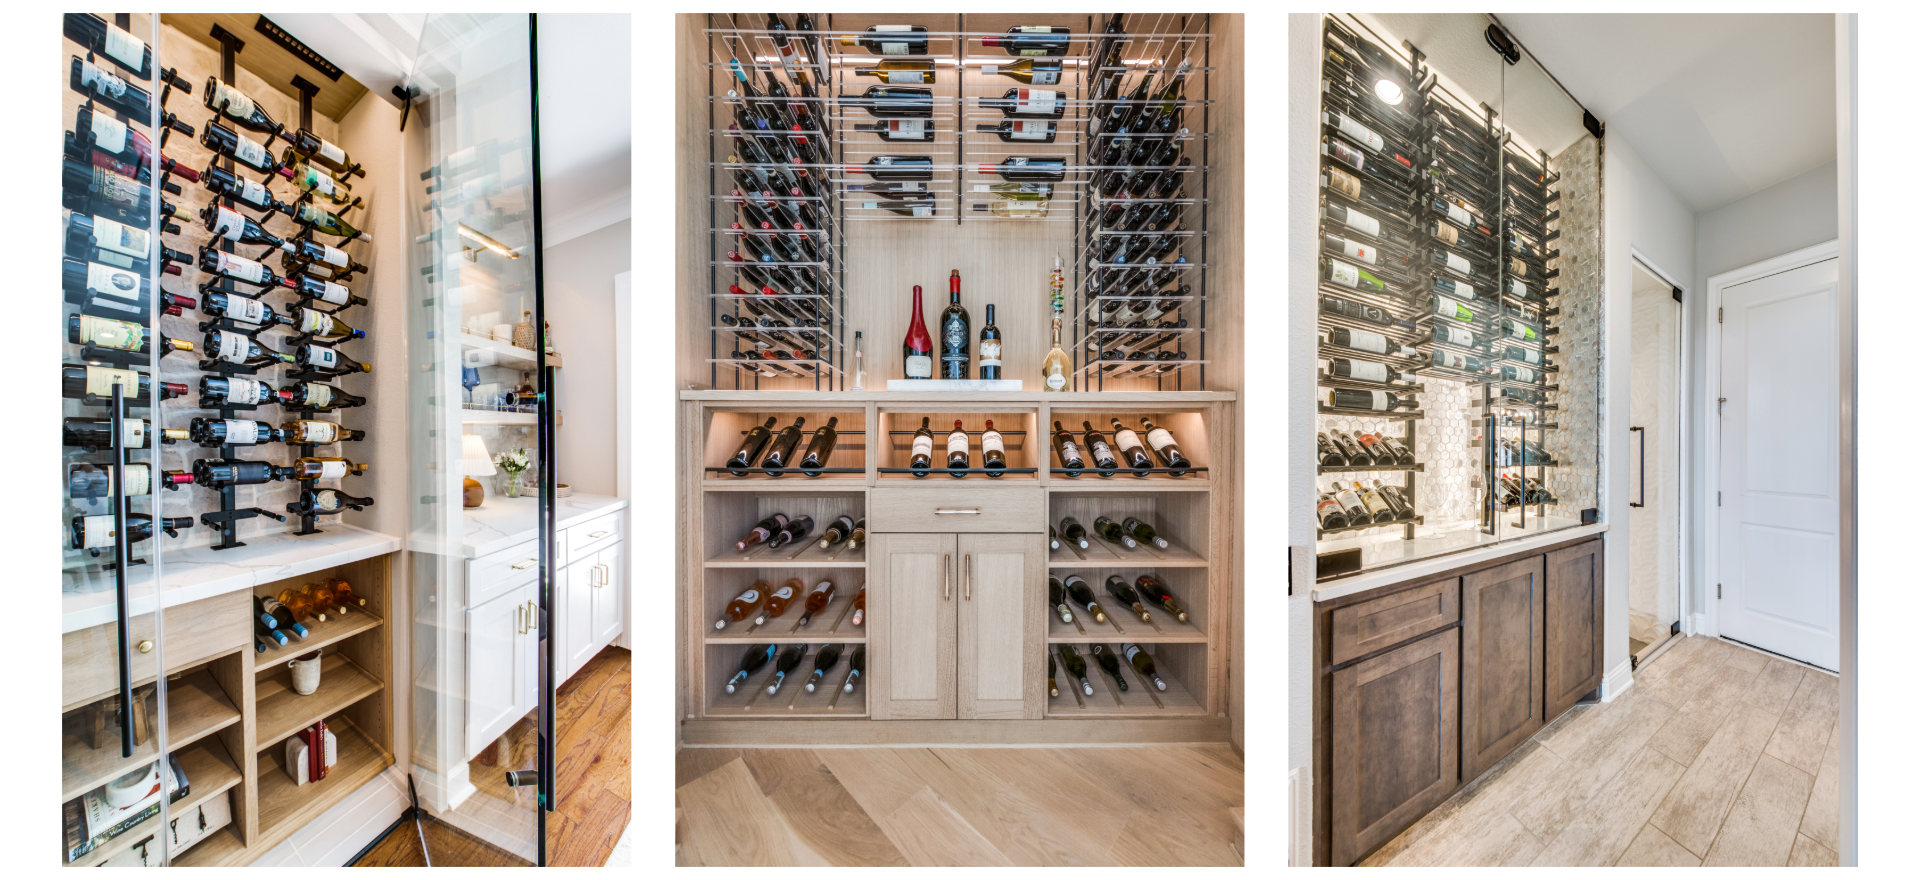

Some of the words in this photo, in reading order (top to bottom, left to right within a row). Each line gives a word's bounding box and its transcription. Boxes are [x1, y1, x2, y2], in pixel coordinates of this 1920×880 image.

[109, 826, 124, 837] Wine
[124, 815, 144, 830] Country
[144, 807, 159, 819] Living
